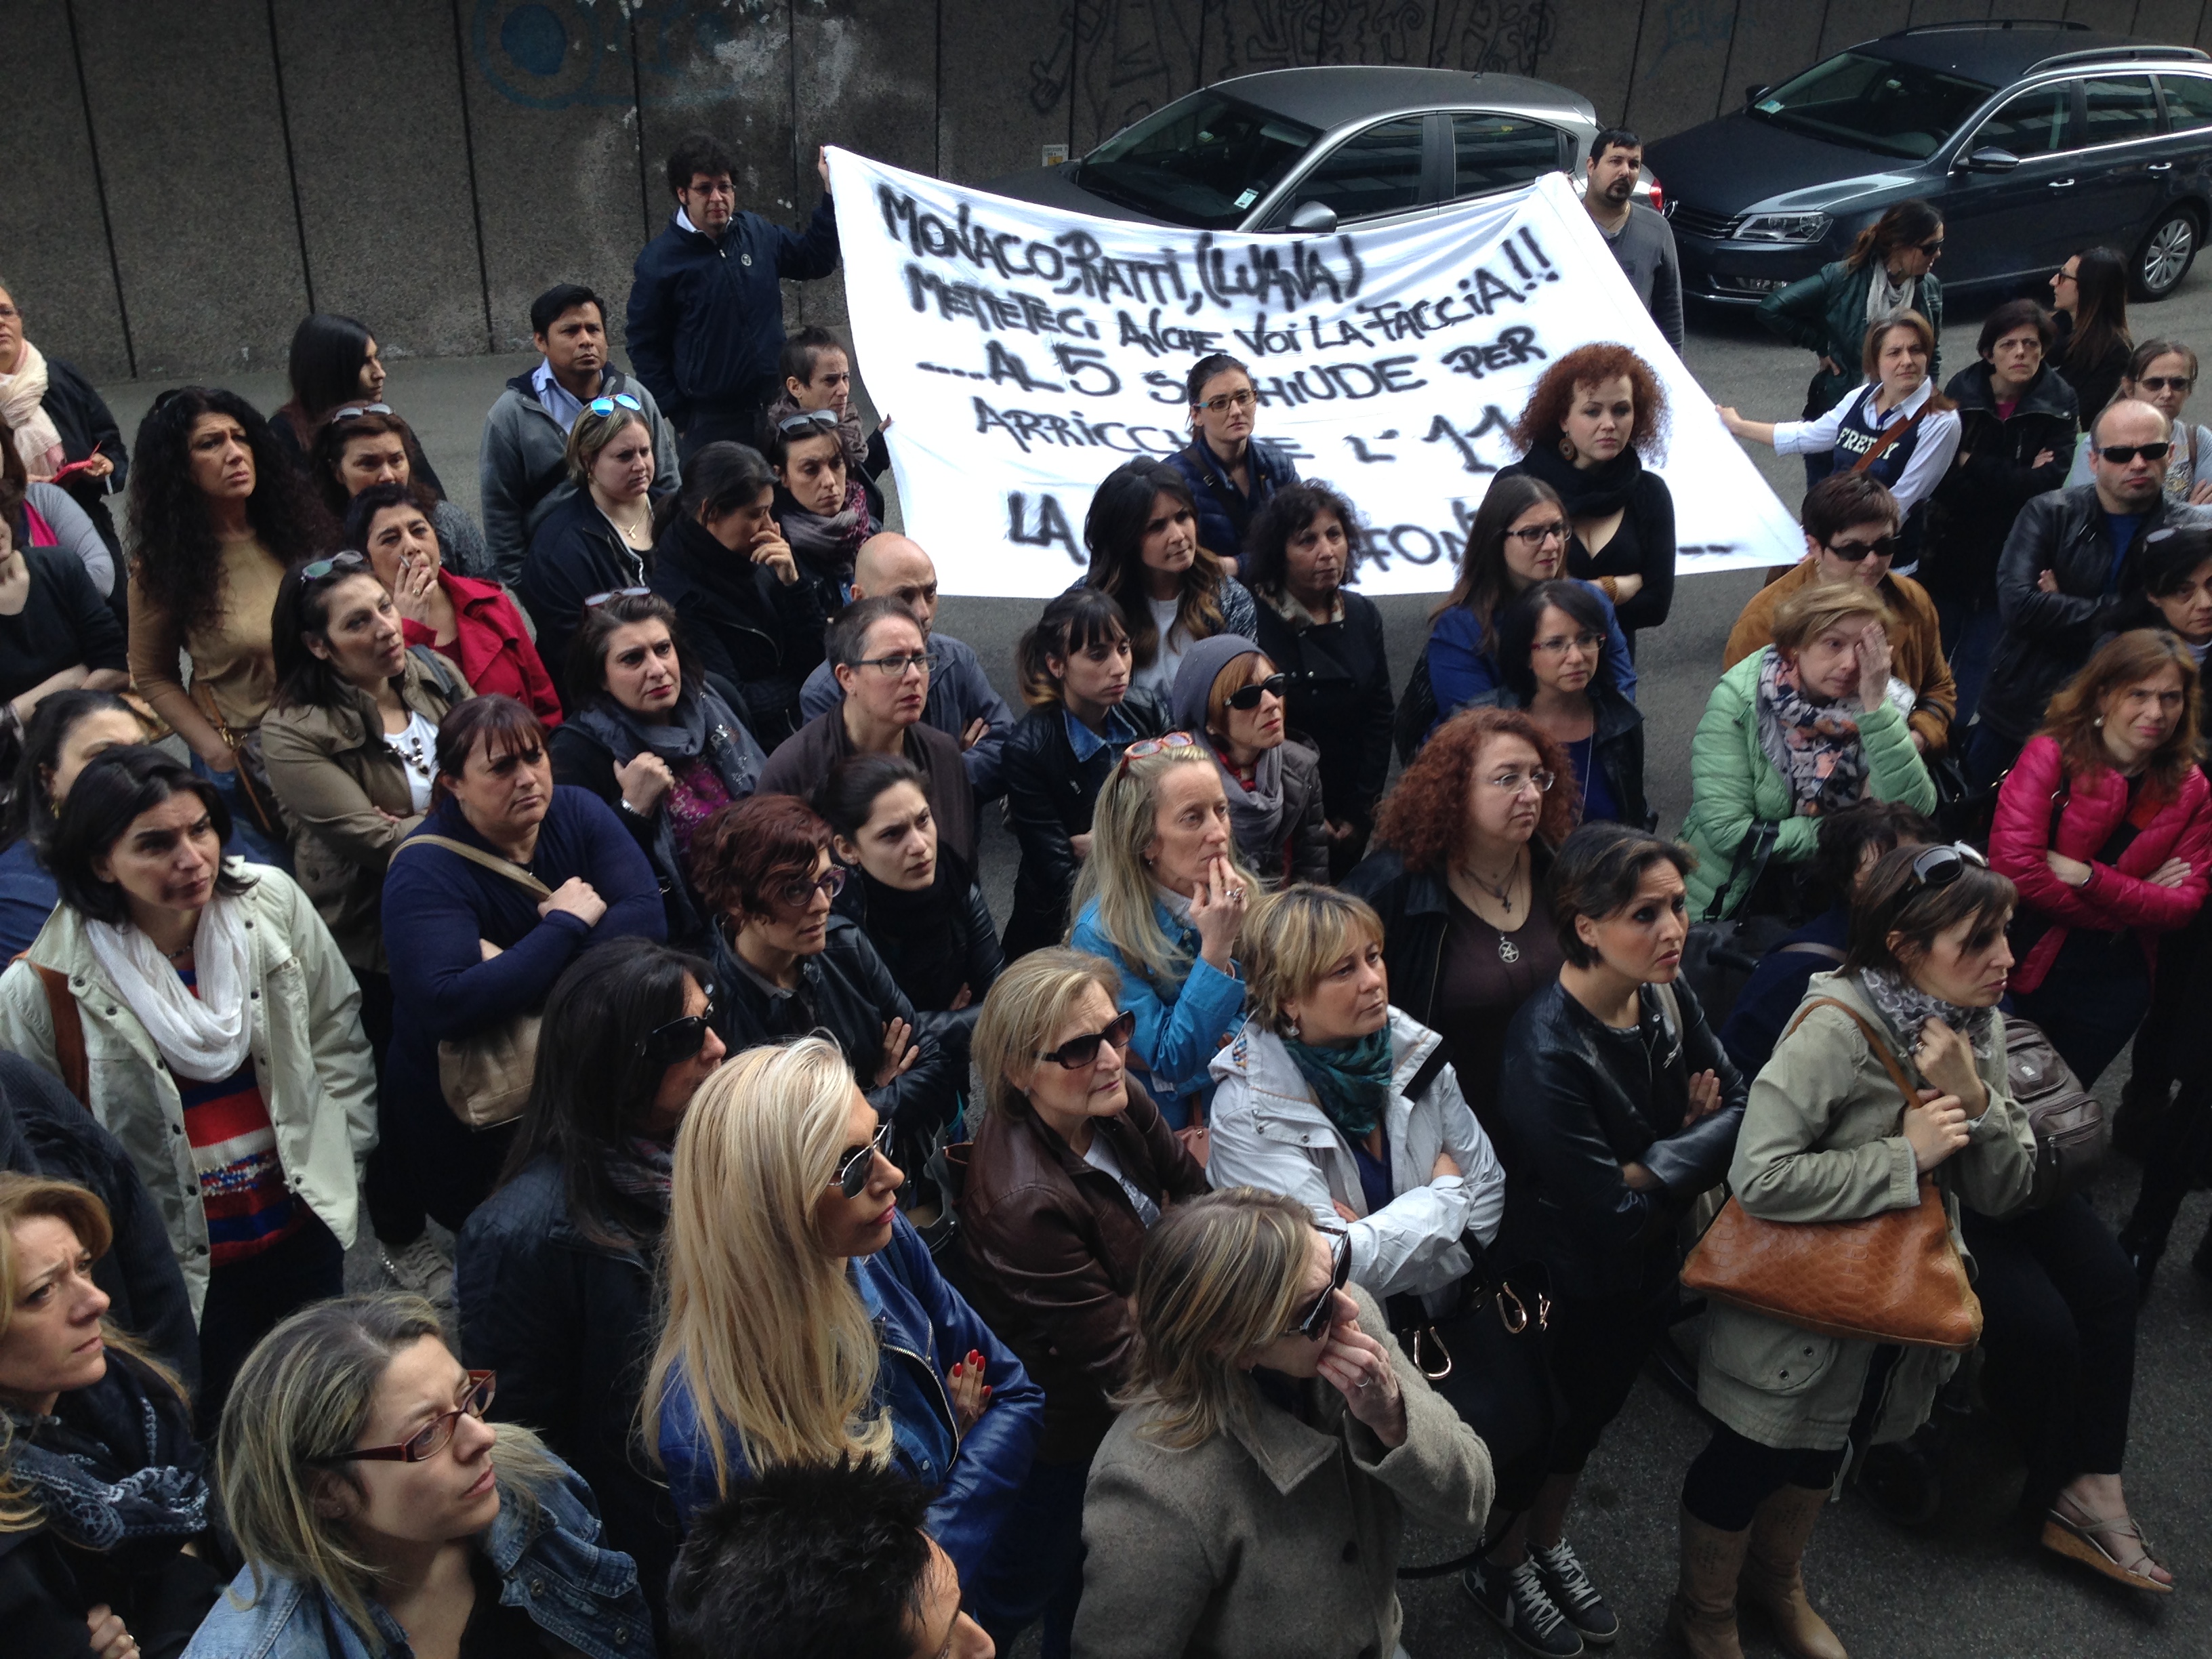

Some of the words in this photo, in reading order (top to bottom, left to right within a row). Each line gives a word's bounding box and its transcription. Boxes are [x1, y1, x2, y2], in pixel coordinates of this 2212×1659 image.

[1195, 231, 1365, 312] (LUANA)
[1052, 342, 1122, 397] 5
[1252, 354, 1429, 408] HIUDE
[1441, 325, 1548, 380] PER
[1117, 308, 1227, 357] ANCHE
[1309, 315, 1376, 350] LA
[1007, 489, 1088, 566] LA
